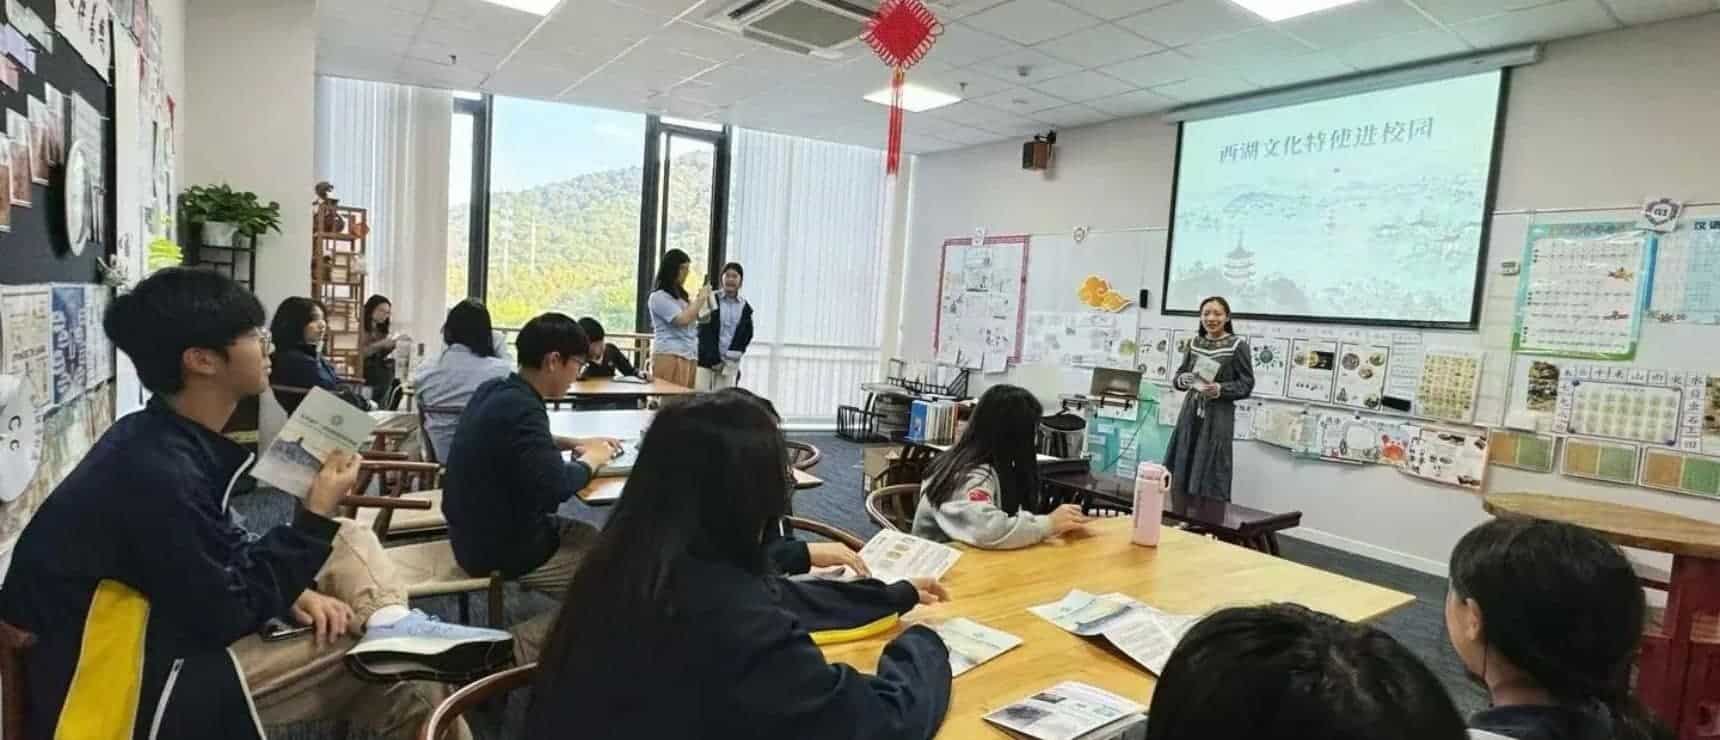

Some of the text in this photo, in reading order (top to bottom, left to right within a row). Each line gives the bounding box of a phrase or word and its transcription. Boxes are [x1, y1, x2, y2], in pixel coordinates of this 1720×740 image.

[1219, 117, 1434, 163] 西湖文化特使进校园
